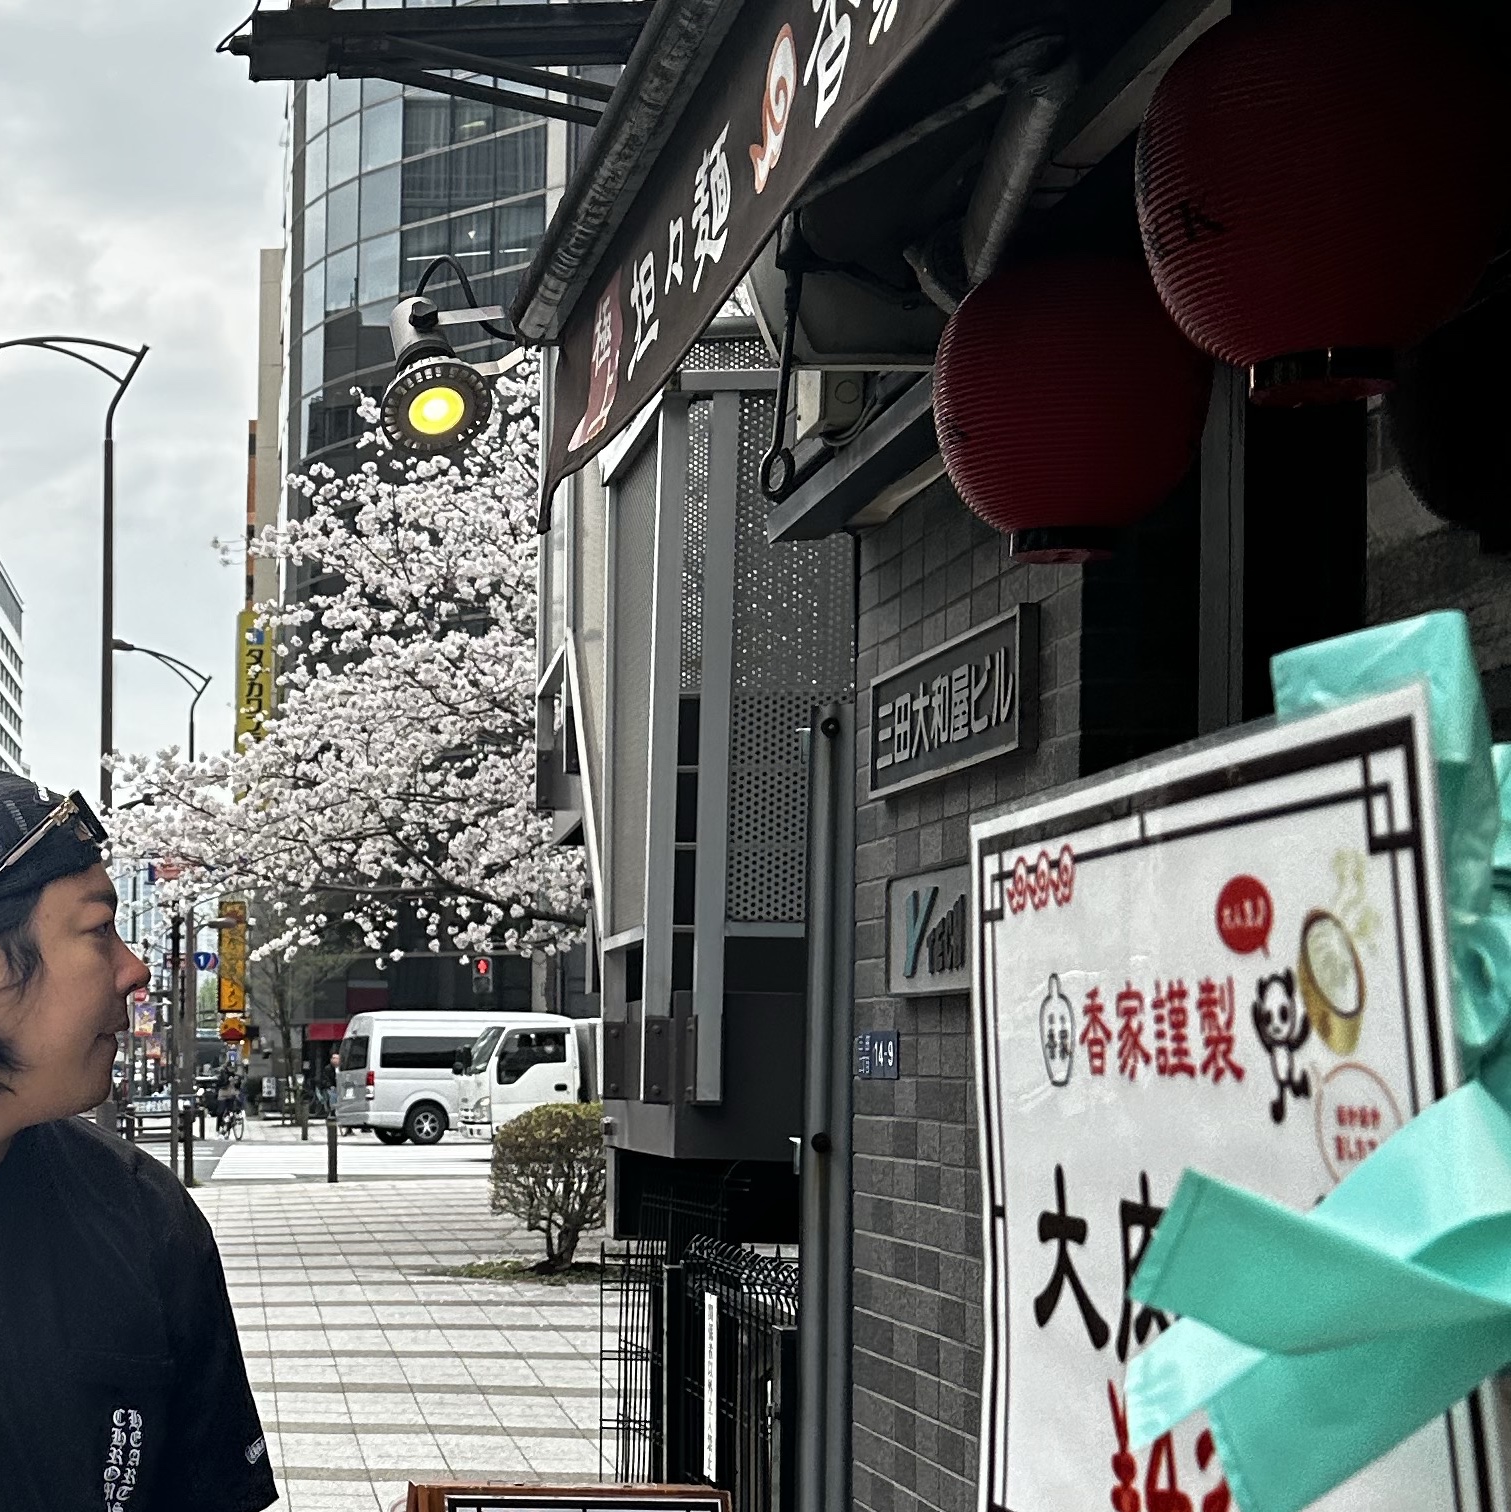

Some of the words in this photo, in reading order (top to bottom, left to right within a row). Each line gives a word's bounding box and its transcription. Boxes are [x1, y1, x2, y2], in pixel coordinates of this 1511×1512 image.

[627, 120, 732, 382] 担々麺
[876, 646, 1014, 771] 三田大和屋ビル
[874, 1040, 895, 1068] 14-9
[1079, 974, 1246, 1086] 香家謹製
